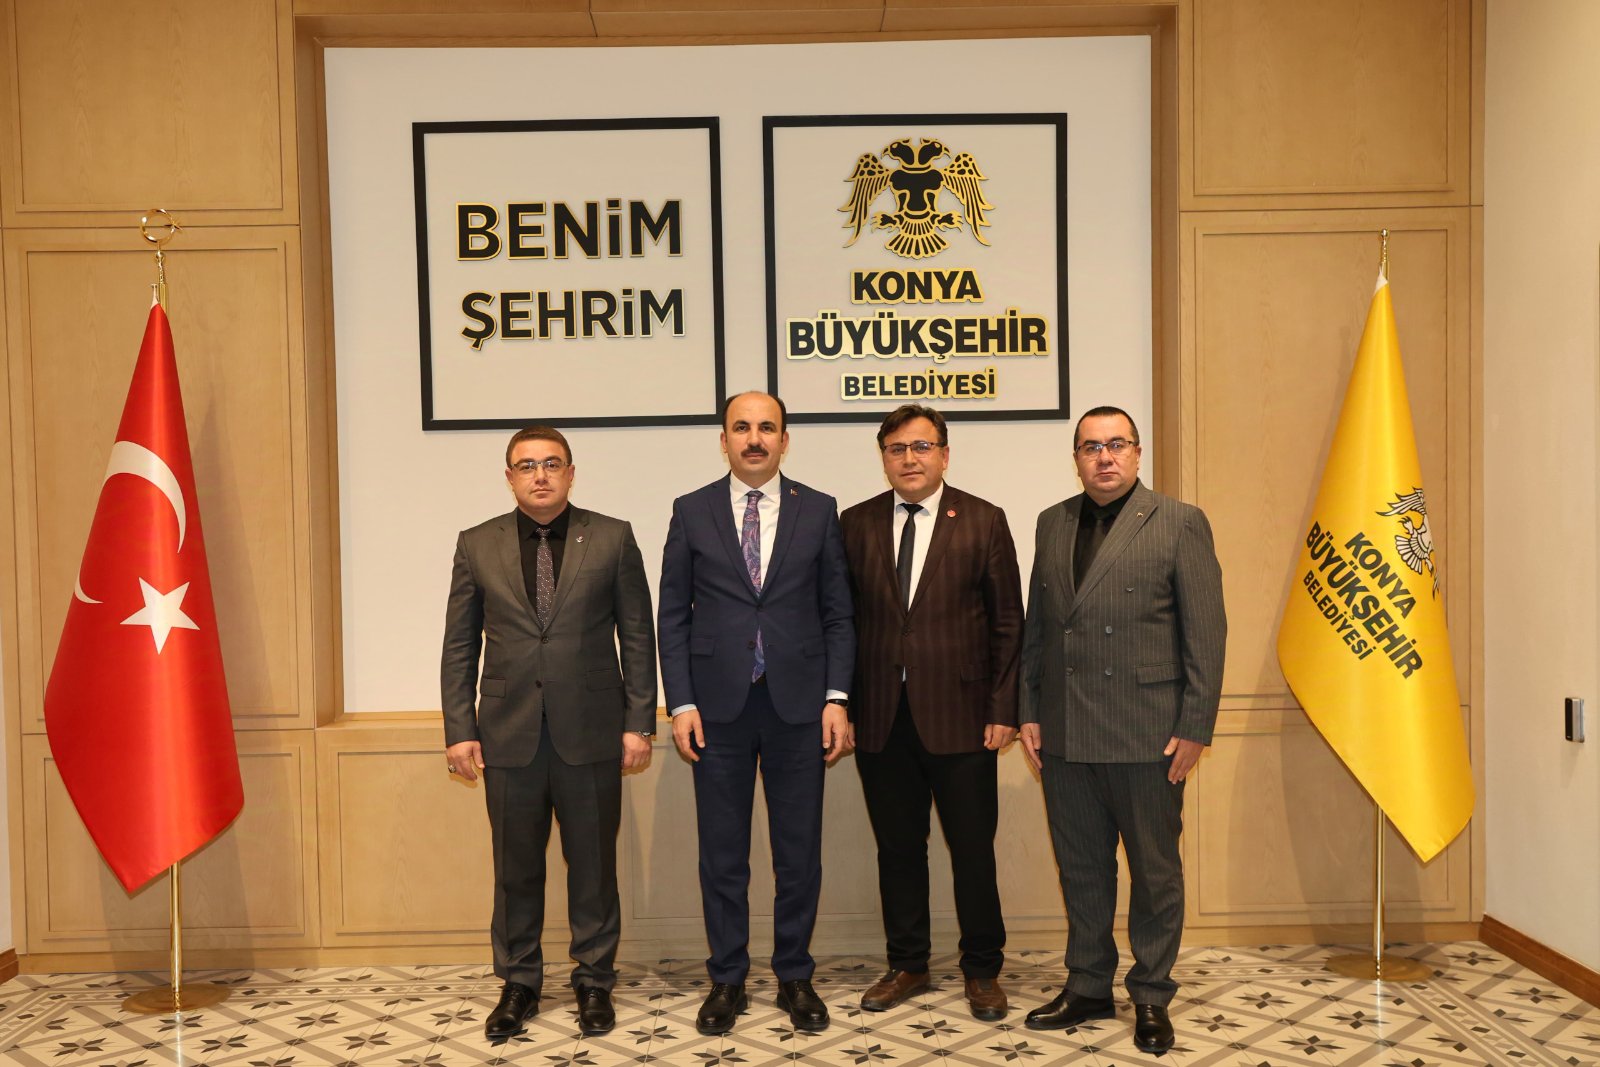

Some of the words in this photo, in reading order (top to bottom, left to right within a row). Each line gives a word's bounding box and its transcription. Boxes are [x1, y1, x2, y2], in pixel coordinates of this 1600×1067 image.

[853, 270, 982, 301] KONYA
[789, 309, 1047, 360] BÜYÜKŞEHİR
[844, 368, 995, 397] BELEDİYESİ
[1306, 521, 1423, 679] BÜYÜKŞEHİR
[1344, 532, 1416, 619] KONYA
[1303, 570, 1377, 660] BELEDİYESİ
